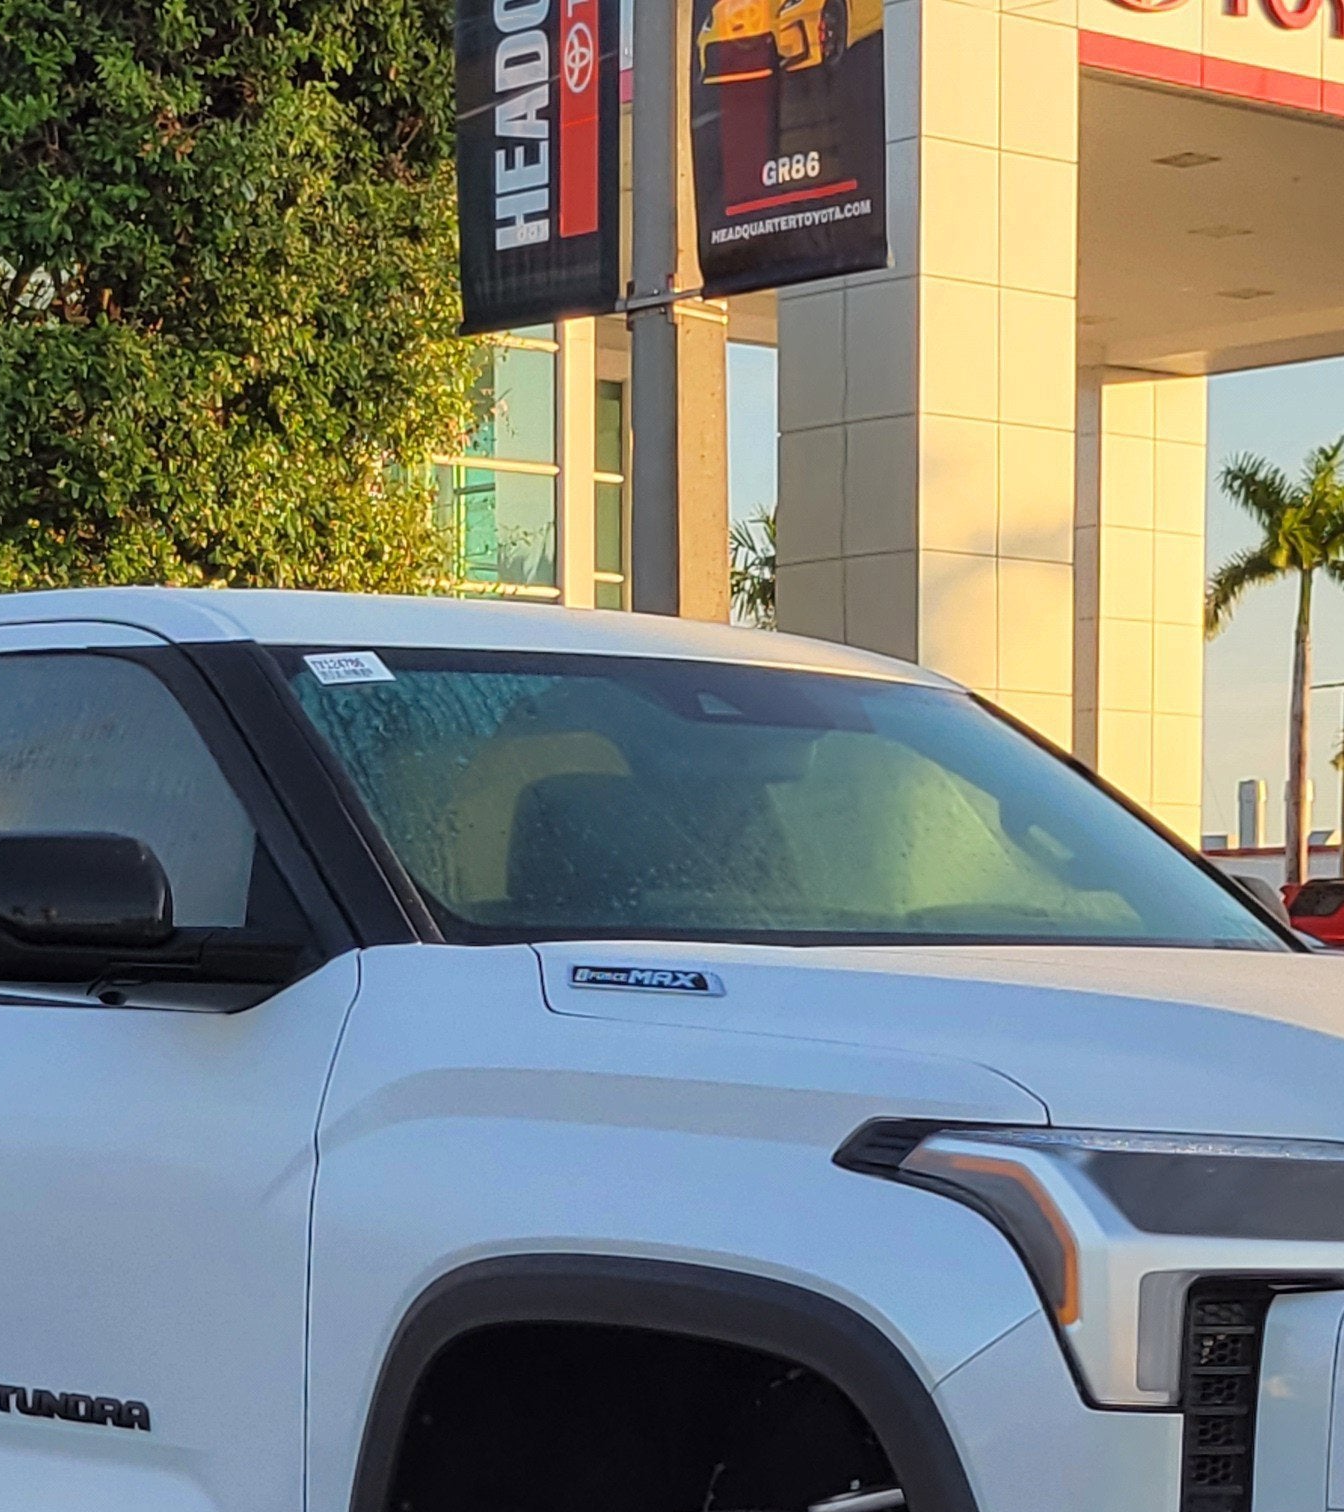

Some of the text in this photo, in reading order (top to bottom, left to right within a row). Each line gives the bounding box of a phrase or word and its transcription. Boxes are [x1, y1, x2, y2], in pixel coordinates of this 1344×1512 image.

[761, 151, 821, 187] GR86
[710, 199, 872, 245] HEADQUARTERTOYOTA.COM
[628, 969, 697, 988] MAX
